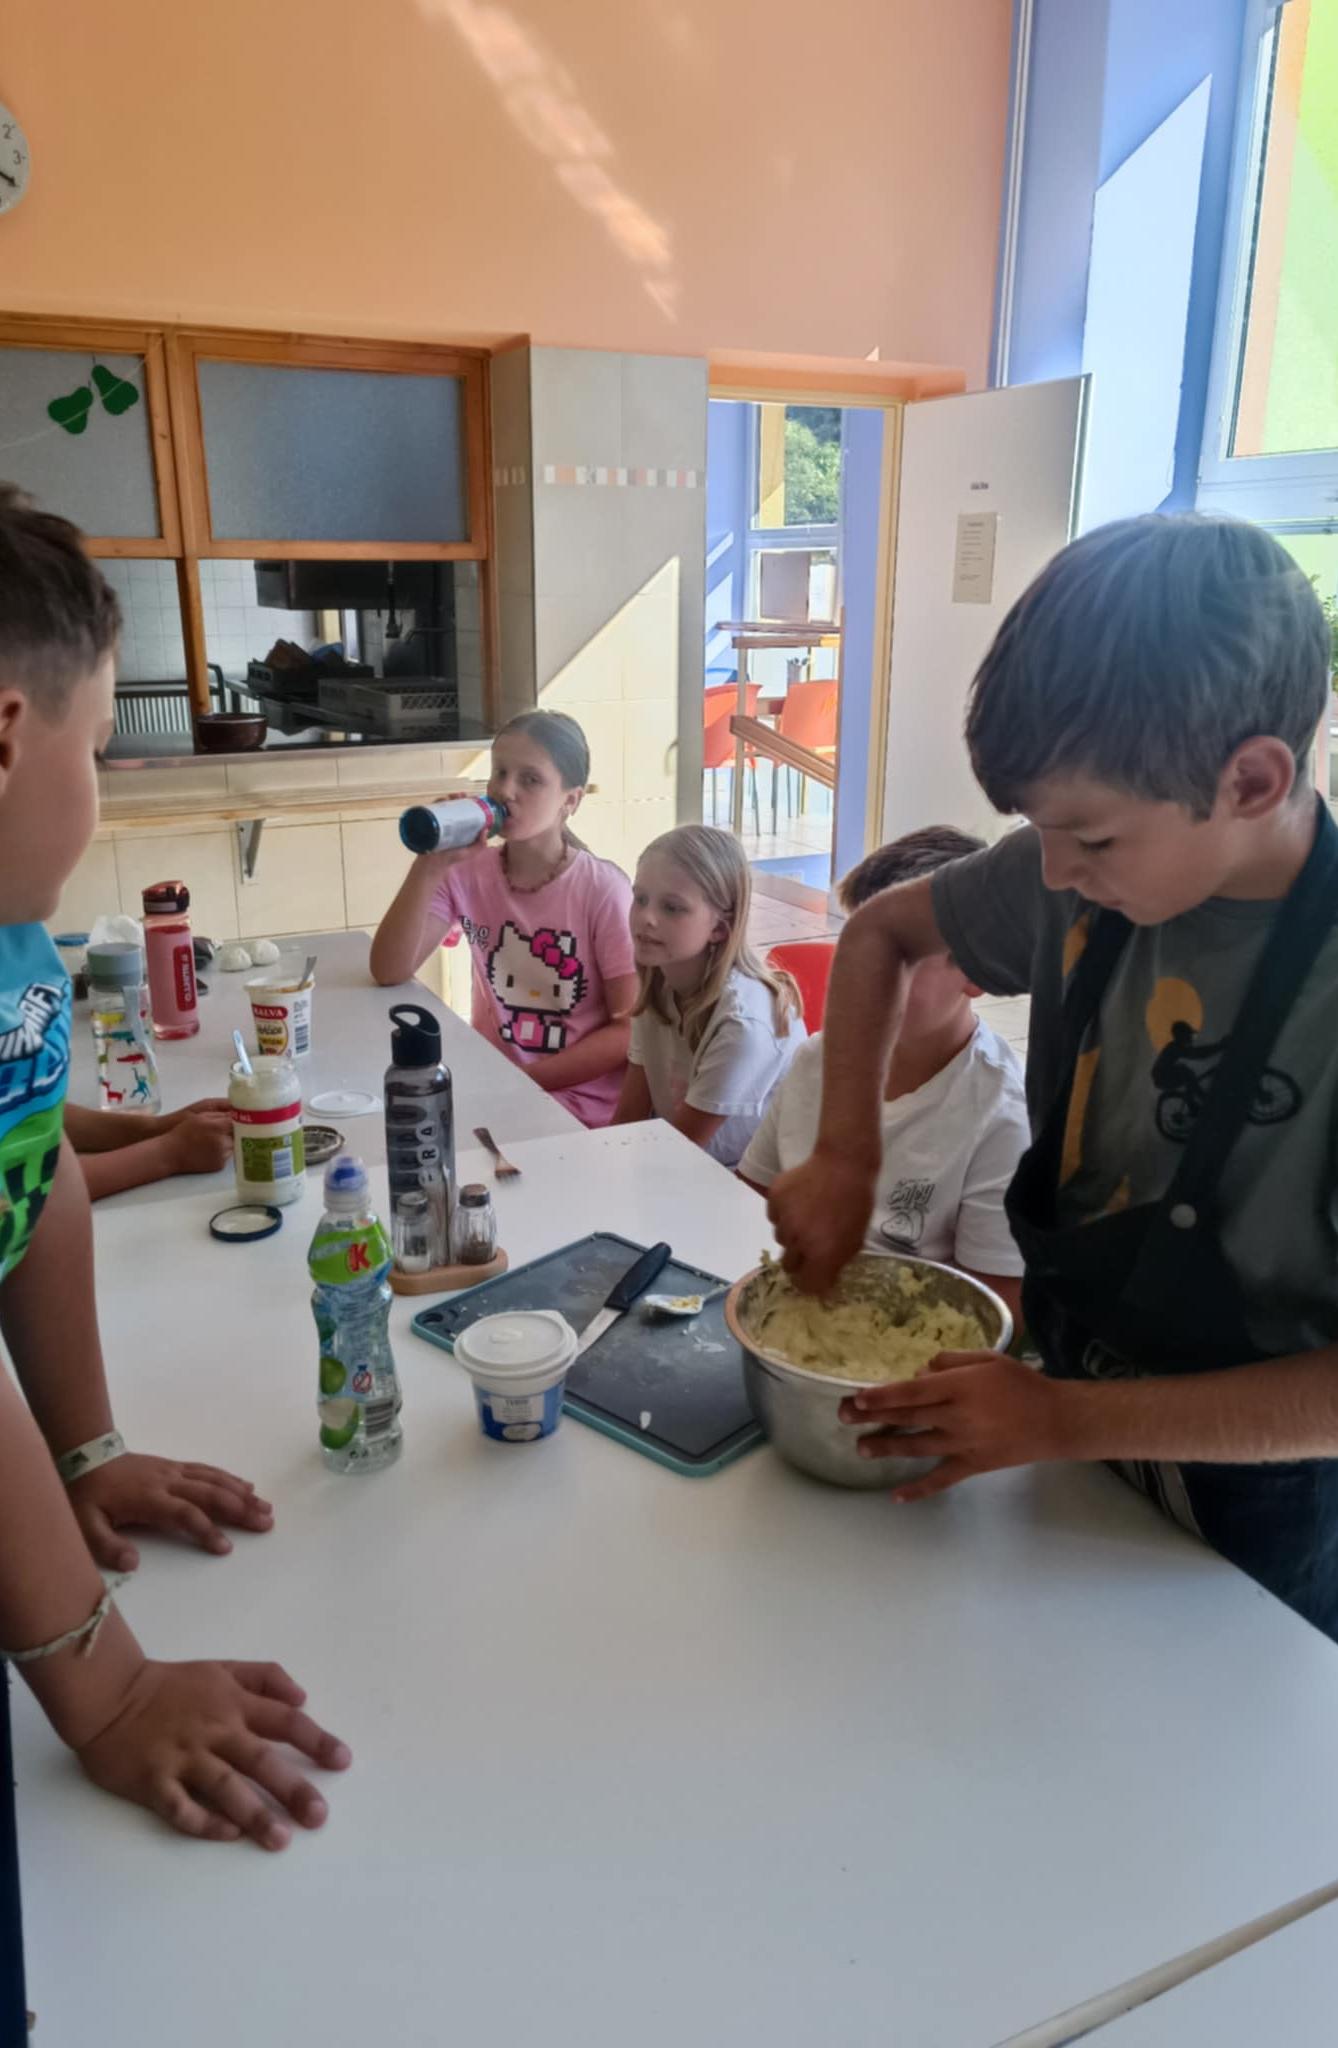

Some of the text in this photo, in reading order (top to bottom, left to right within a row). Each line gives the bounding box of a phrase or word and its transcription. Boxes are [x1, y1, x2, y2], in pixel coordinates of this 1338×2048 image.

[2, 123, 13, 140] 2
[12, 149, 22, 165] 3
[348, 1241, 372, 1273] K
